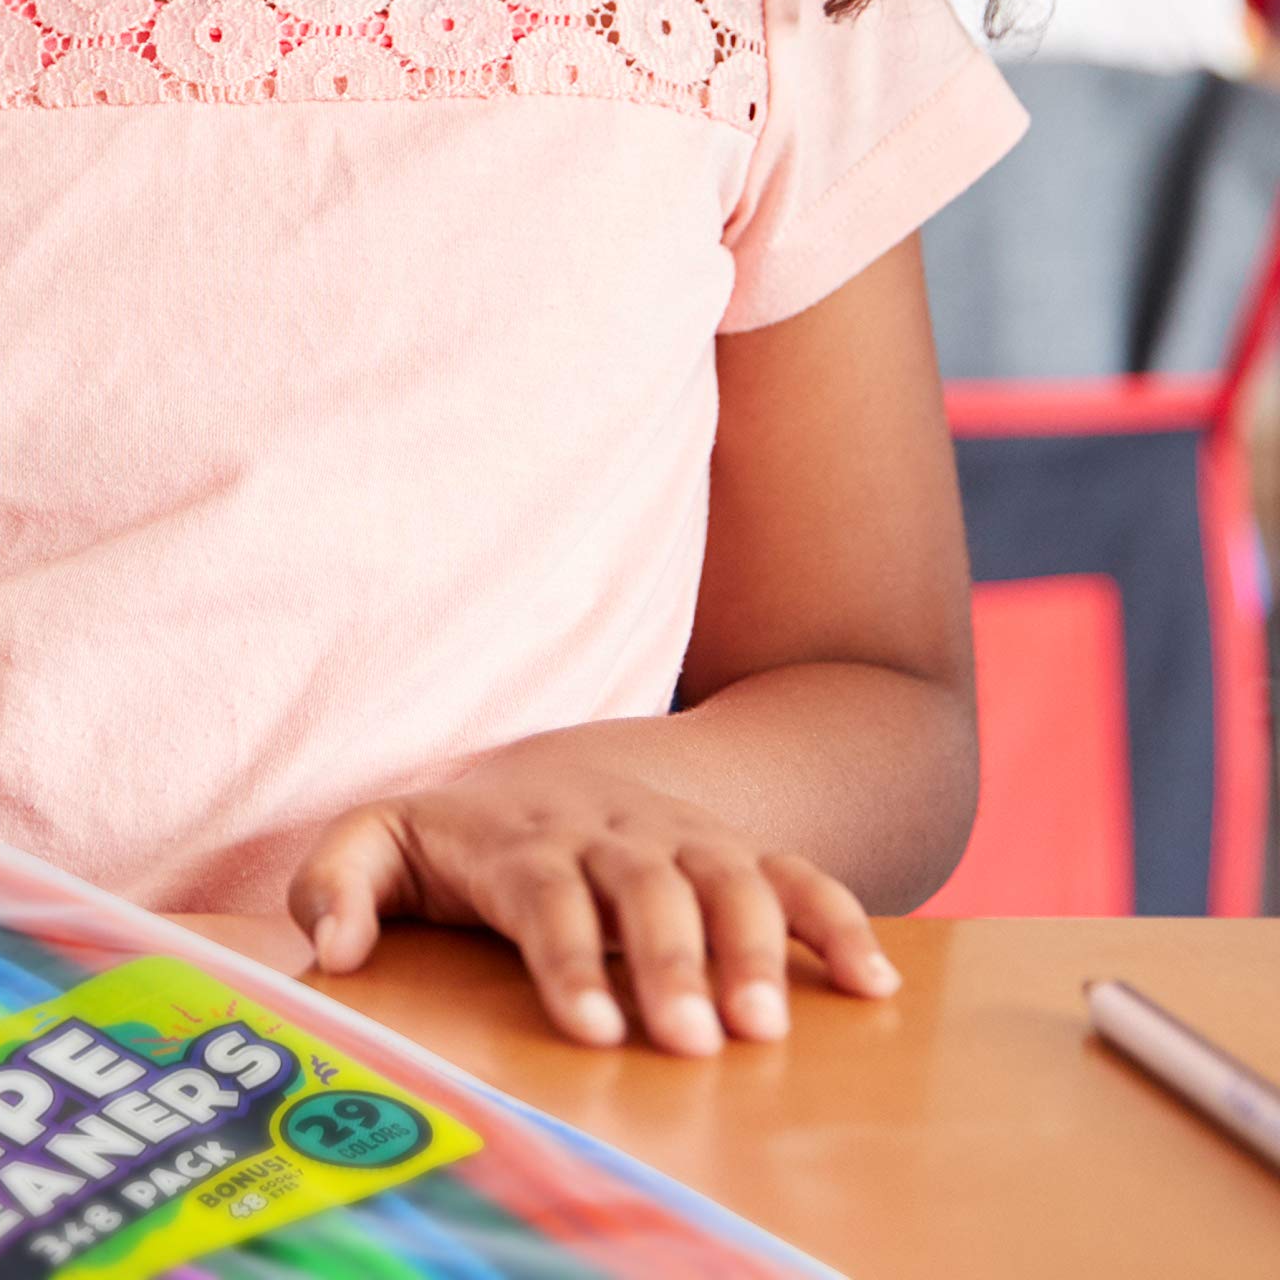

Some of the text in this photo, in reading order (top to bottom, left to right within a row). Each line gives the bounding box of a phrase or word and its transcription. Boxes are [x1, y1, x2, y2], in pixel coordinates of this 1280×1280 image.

[294, 1097, 382, 1149] 29
[337, 1122, 412, 1160] COLORS
[30, 1140, 236, 1264] 348 PACK
[197, 1155, 293, 1208] BONUS!
[228, 1193, 269, 1219] 48
